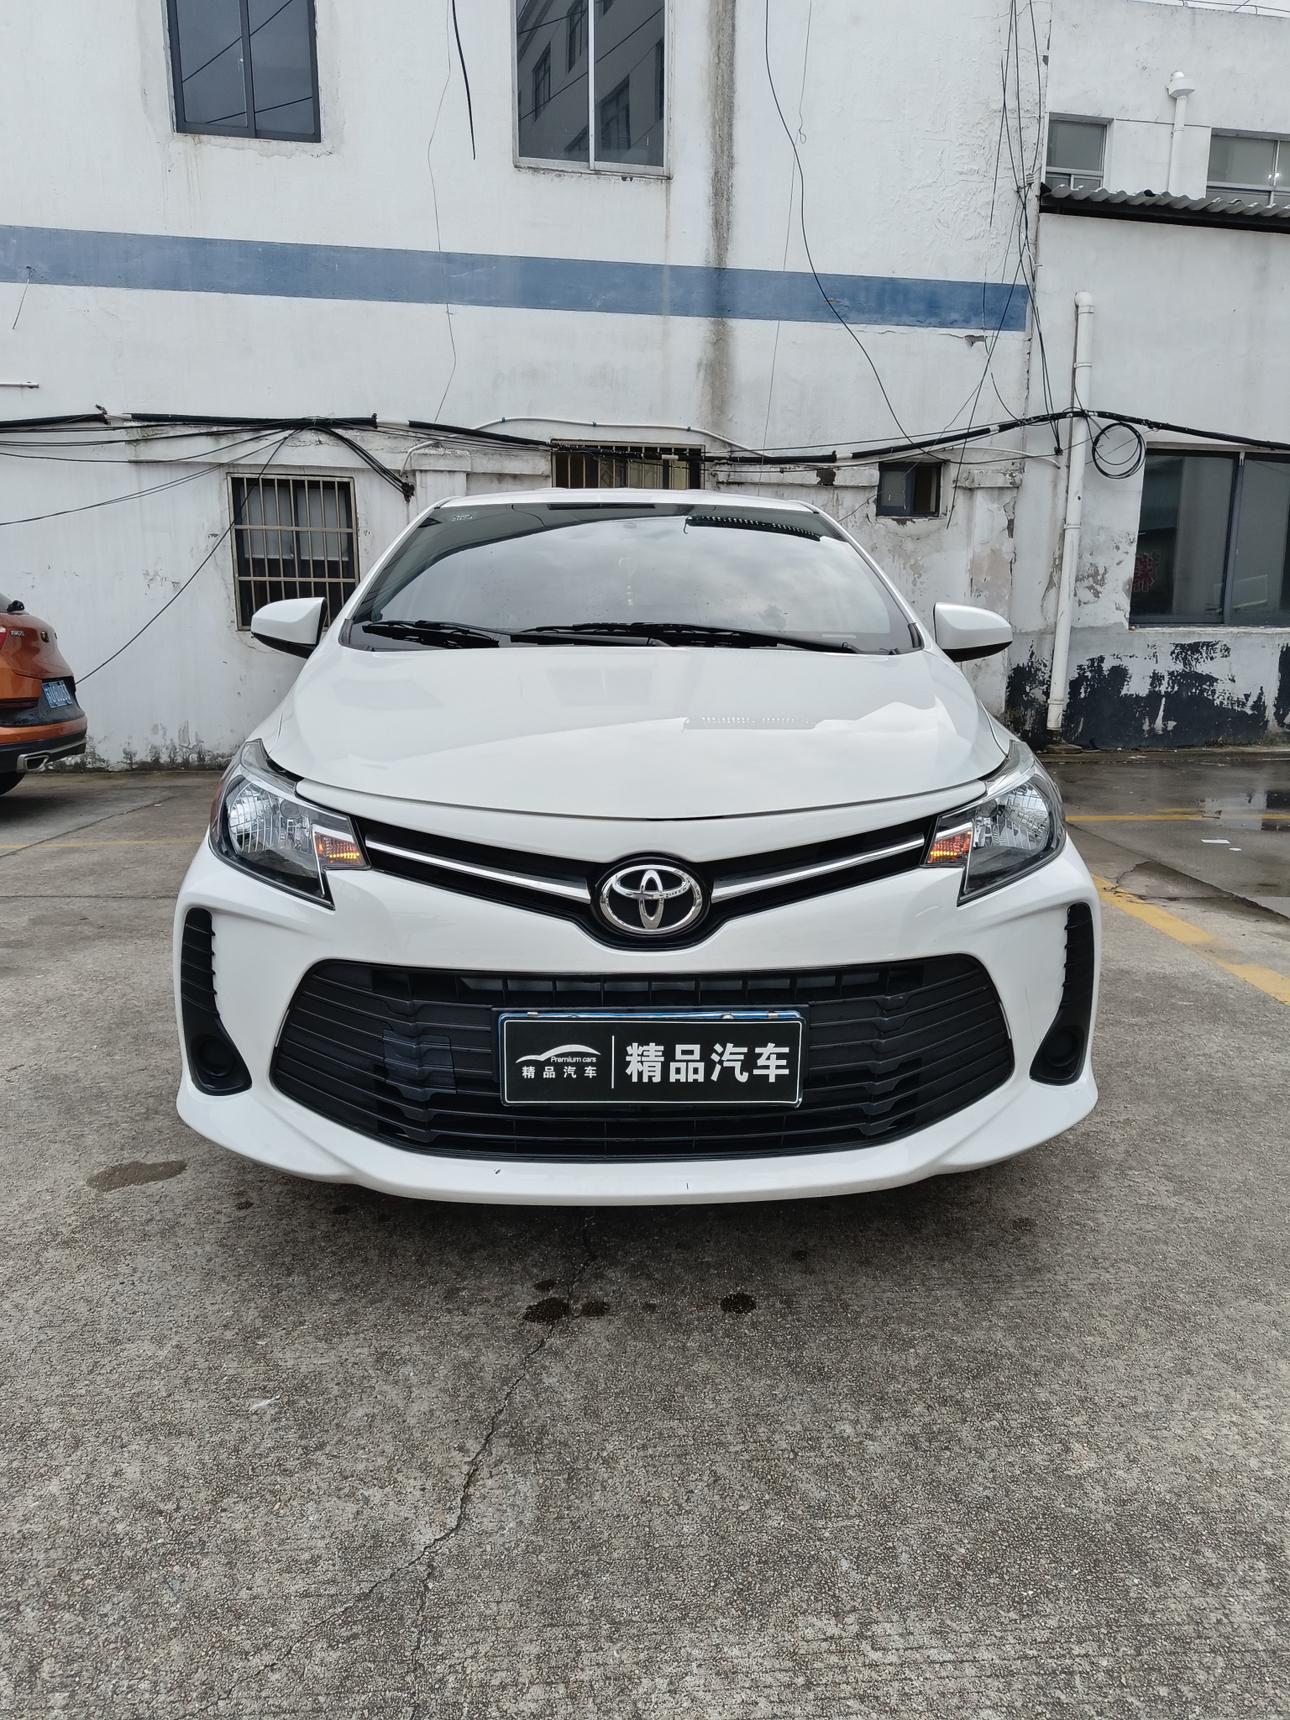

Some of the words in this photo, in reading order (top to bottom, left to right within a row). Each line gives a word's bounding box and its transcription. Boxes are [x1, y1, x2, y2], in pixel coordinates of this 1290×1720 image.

[521, 1066, 597, 1079] 精品汽车
[625, 1042, 790, 1083] 精品汽车
